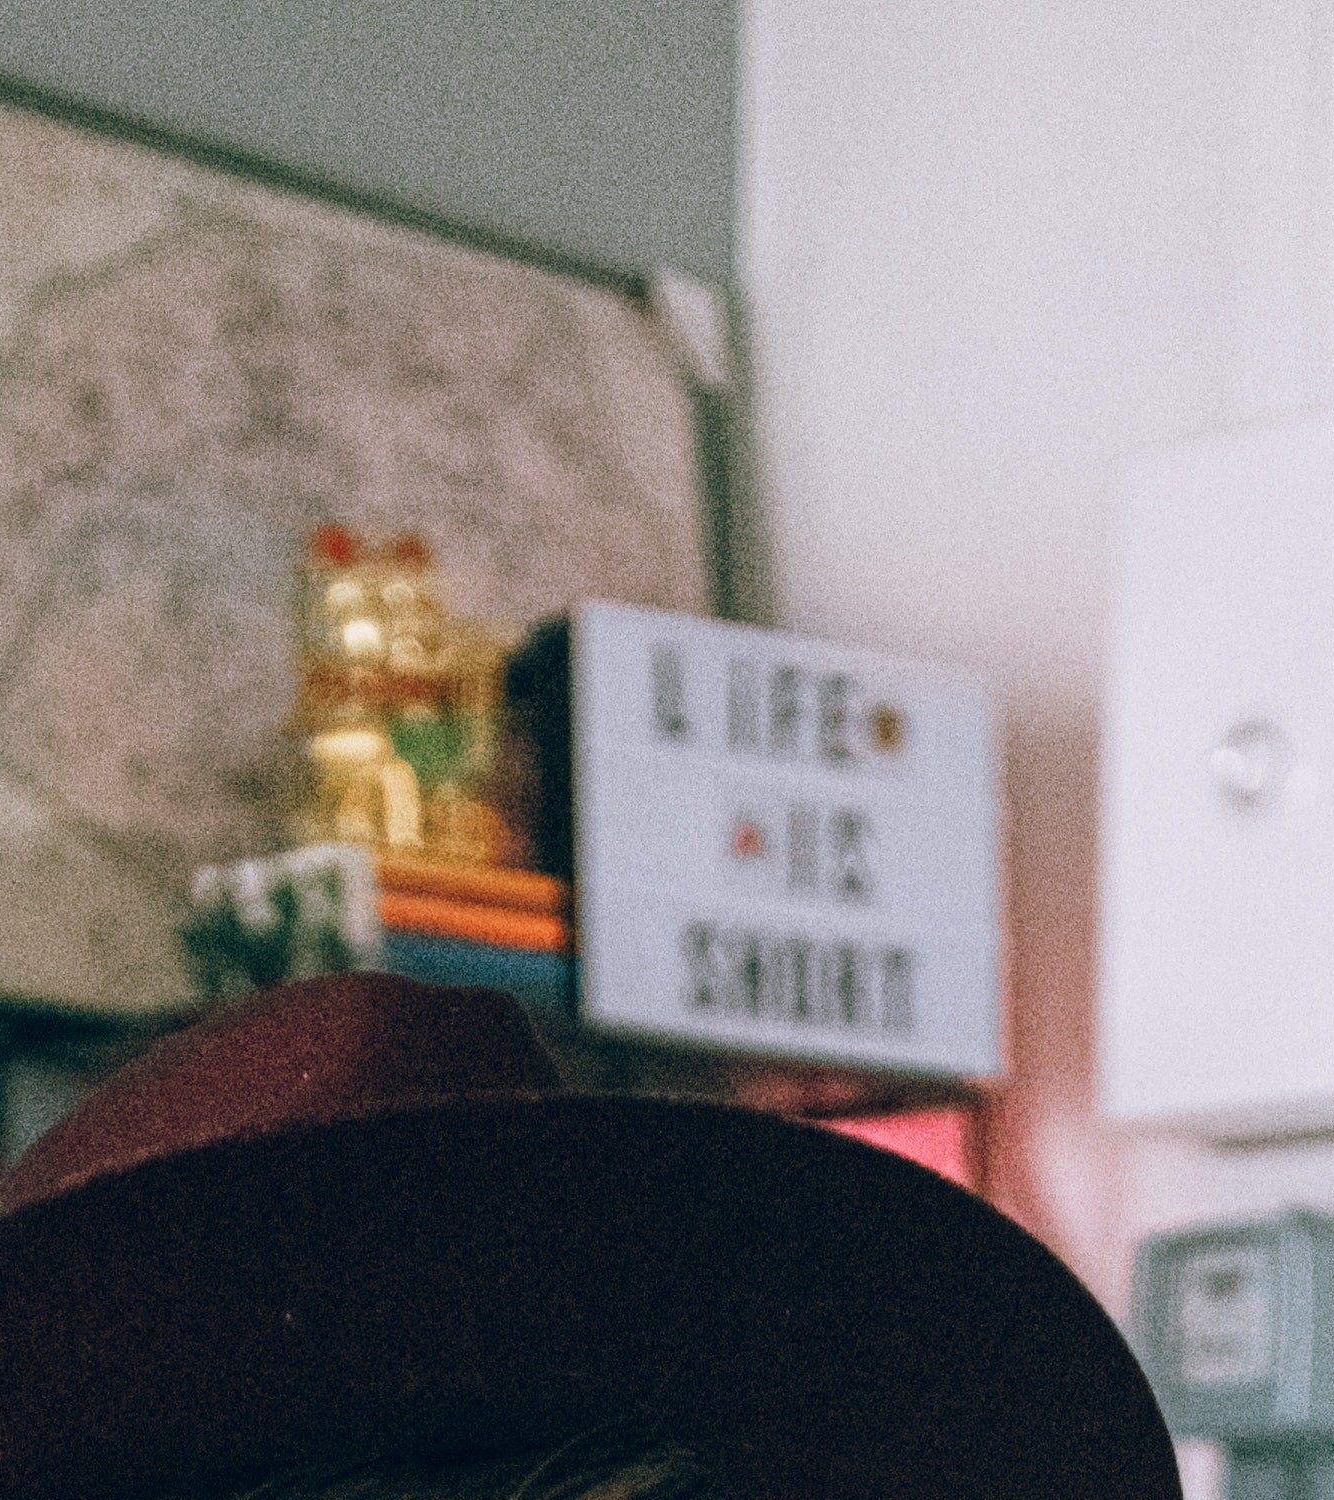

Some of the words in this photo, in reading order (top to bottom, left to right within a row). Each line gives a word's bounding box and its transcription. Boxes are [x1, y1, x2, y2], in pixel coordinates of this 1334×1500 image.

[651, 640, 857, 768] LIFE
[783, 802, 871, 902] IS
[681, 920, 914, 1032] SHORT
